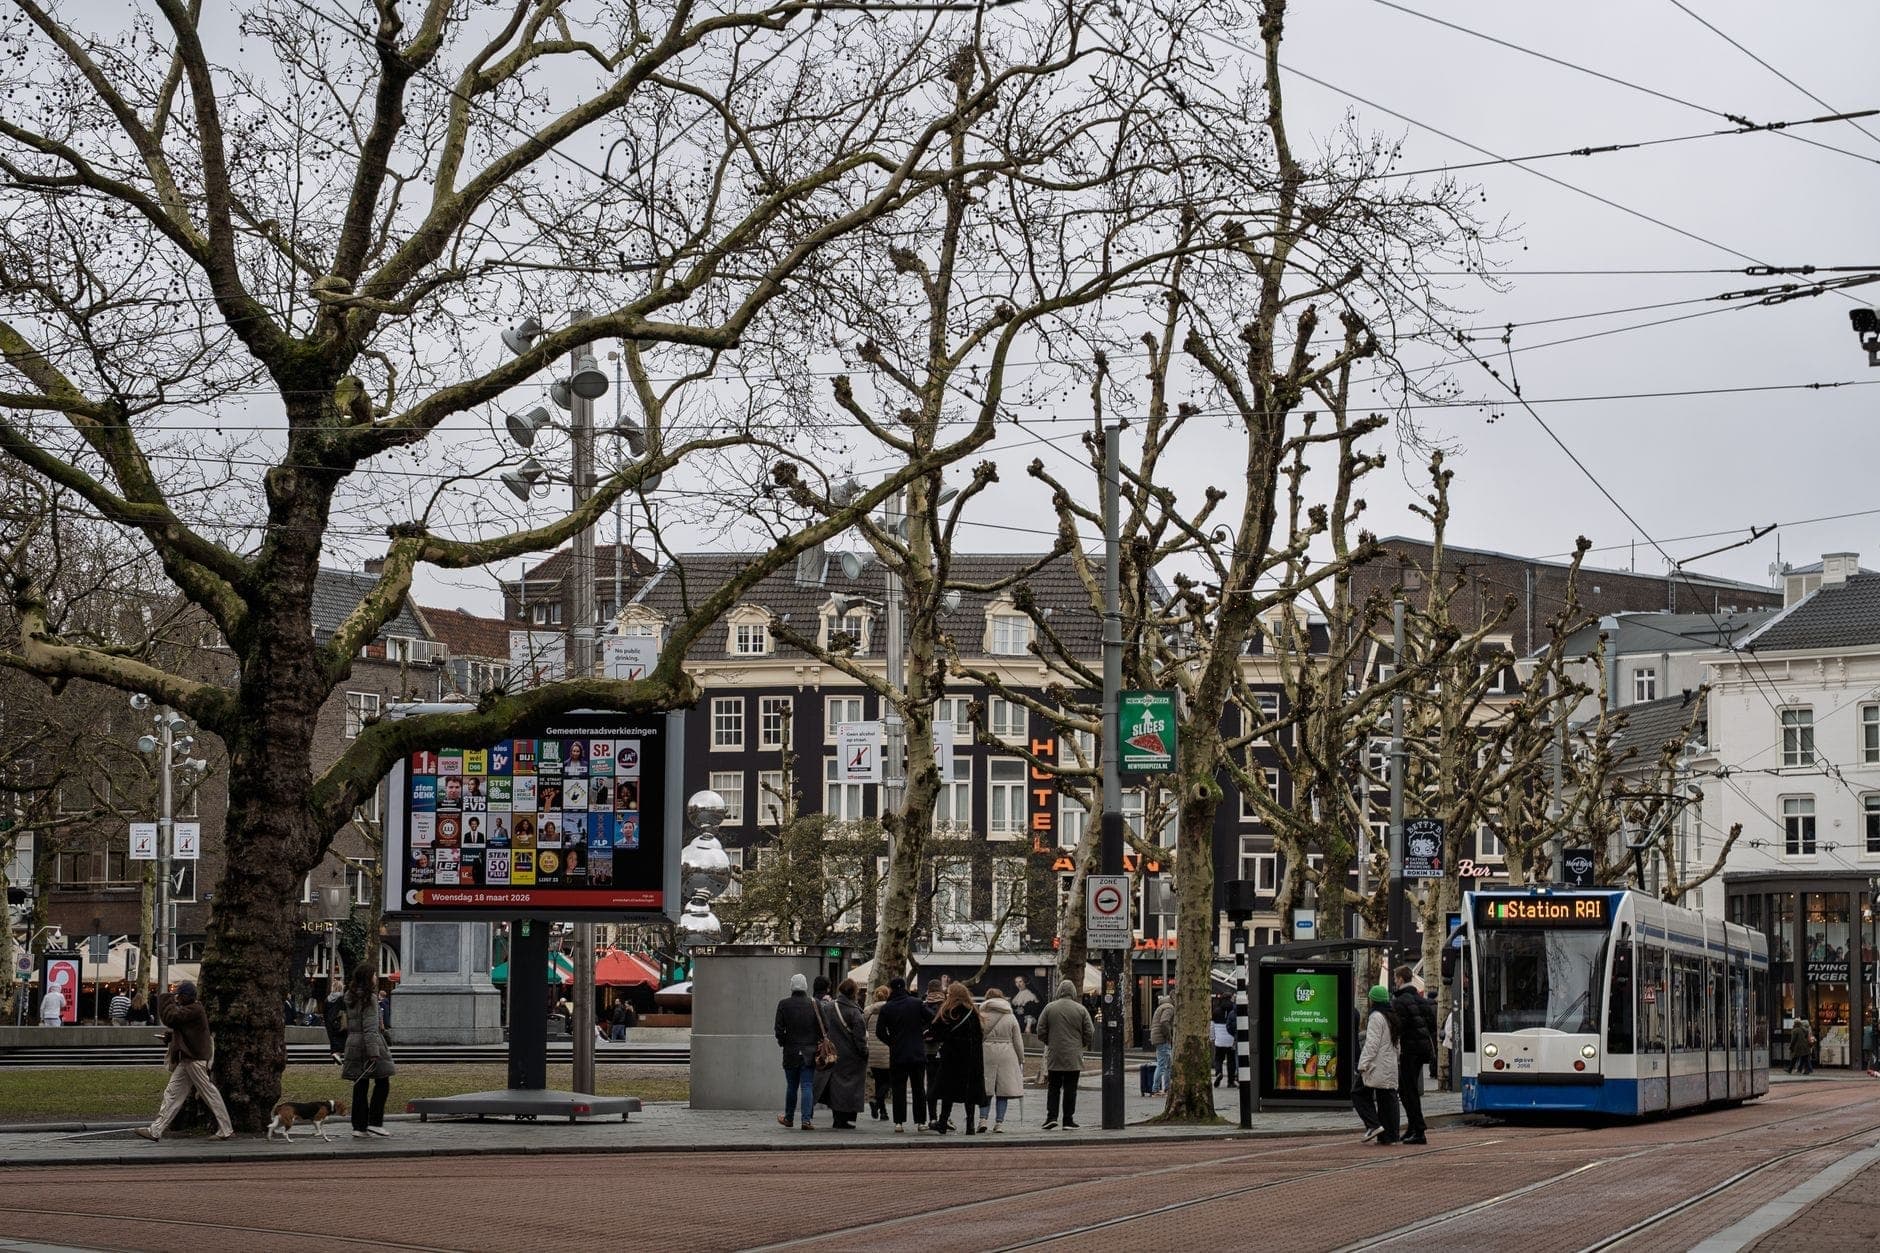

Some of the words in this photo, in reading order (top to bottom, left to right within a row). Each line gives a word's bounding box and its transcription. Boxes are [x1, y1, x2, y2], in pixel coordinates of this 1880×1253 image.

[624, 647, 640, 656] public
[615, 655, 640, 663] drinking.
[546, 727, 657, 737] Gemeenteraadsverkiezingen
[1132, 720, 1165, 736] SLICES
[413, 791, 435, 799] DENK
[463, 803, 486, 811] FVD
[1406, 820, 1434, 834] BETTY
[489, 861, 507, 871] 50
[1458, 859, 1491, 877] Bar
[431, 893, 473, 903] Woensdag
[475, 893, 485, 902] 18
[486, 893, 510, 902] maart
[510, 893, 530, 902] 2026
[1487, 901, 1495, 918] 4
[1508, 901, 1569, 918] Station
[1575, 900, 1600, 918] RAI
[772, 946, 809, 955] TOILET
[1296, 986, 1315, 997] fuze
[1296, 994, 1311, 1002] tea
